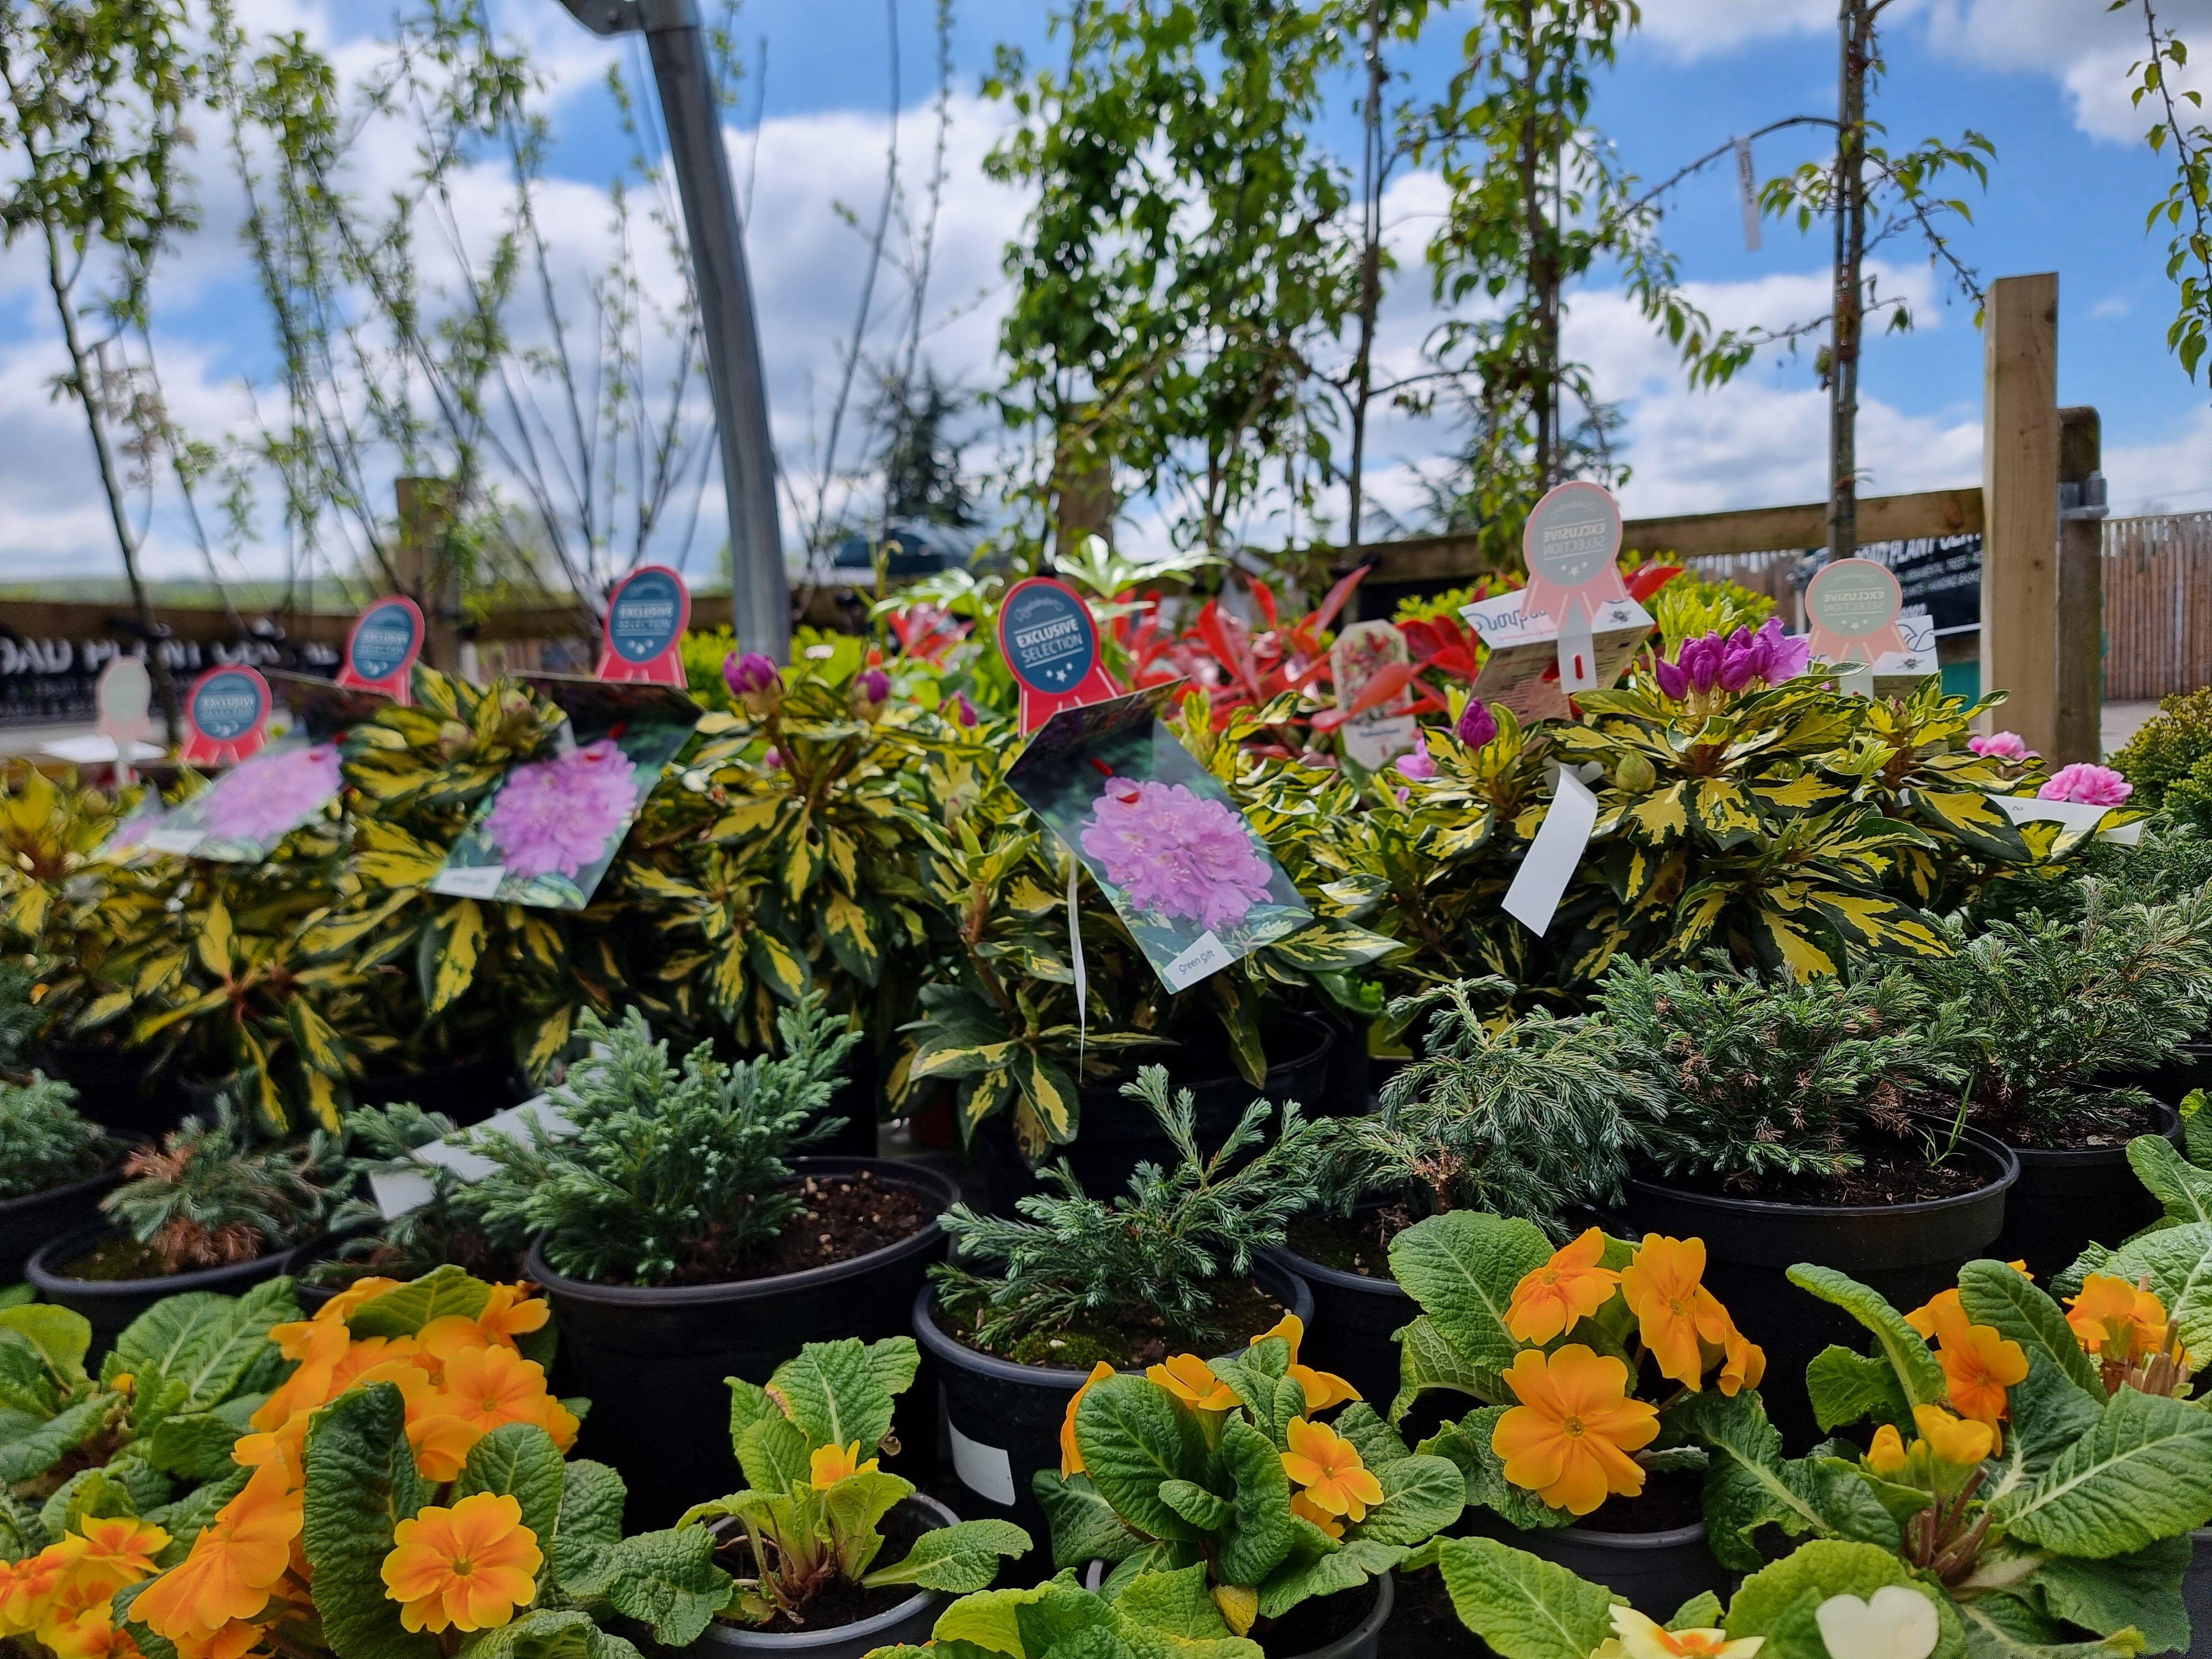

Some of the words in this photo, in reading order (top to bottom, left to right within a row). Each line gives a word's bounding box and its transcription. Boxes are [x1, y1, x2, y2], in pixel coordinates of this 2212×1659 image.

[618, 603, 673, 619] EXCLUSIVE
[1016, 618, 1079, 648] EXCLUSIVE
[1021, 633, 1083, 663] SELECTION
[1179, 957, 1201, 975] Green
[1200, 949, 1215, 963] Gift
